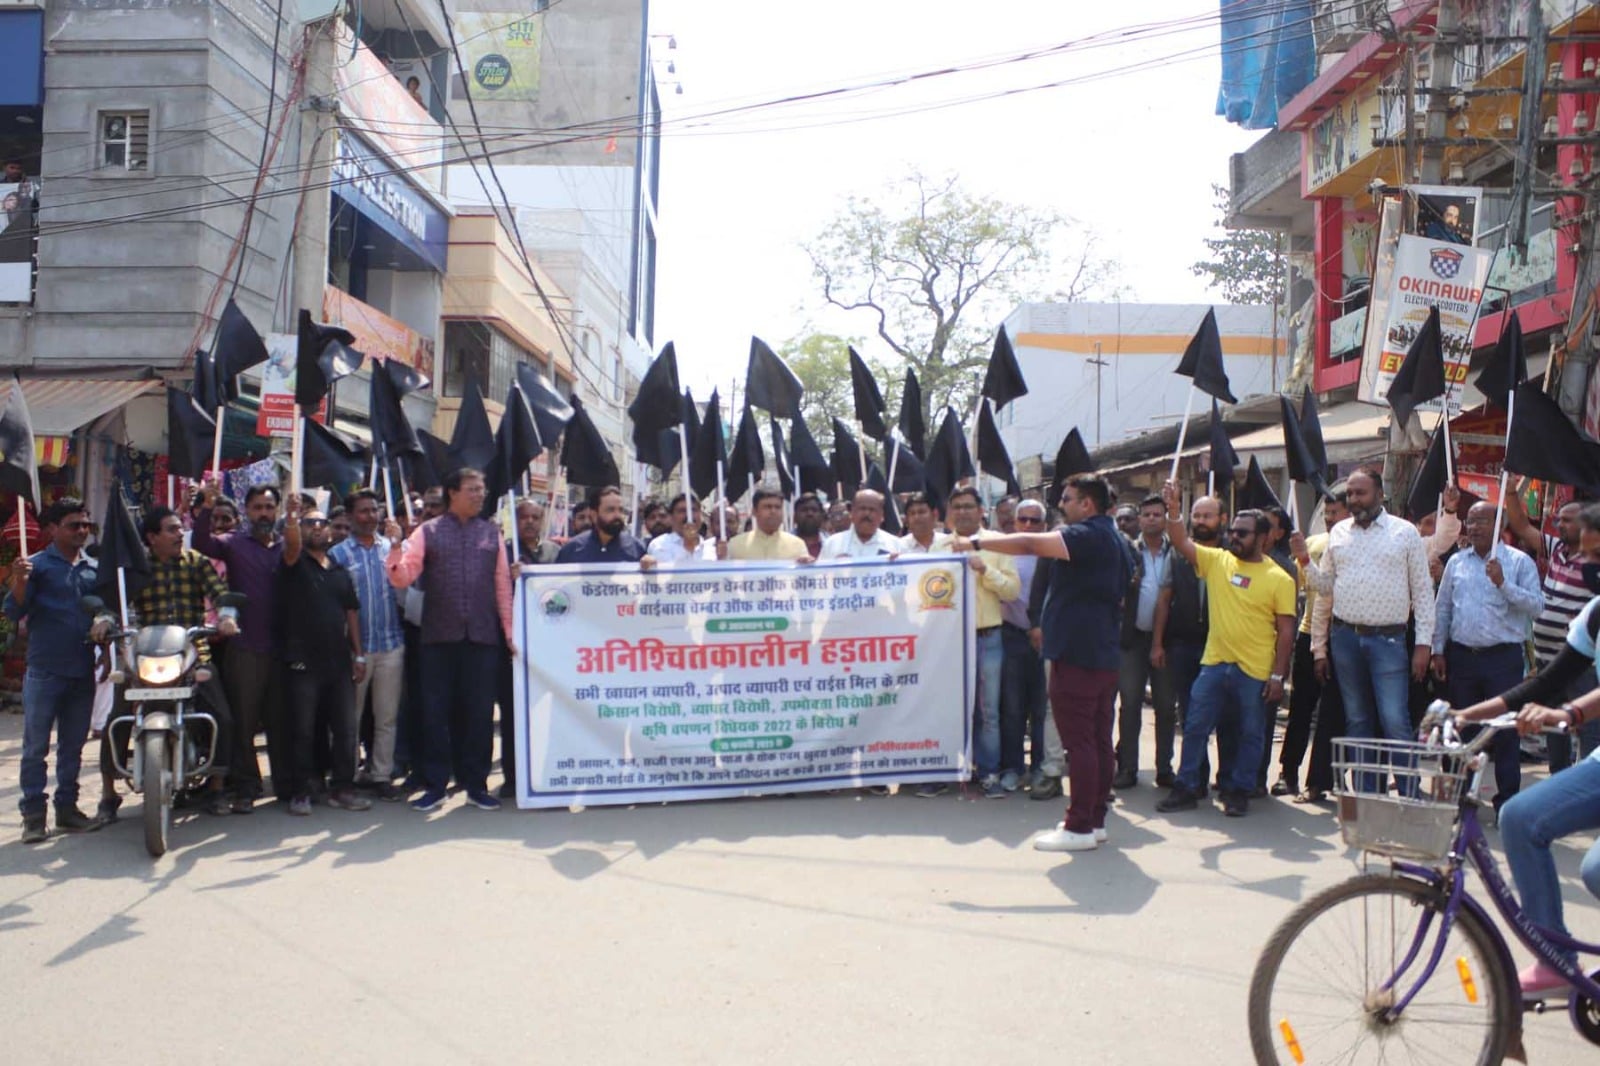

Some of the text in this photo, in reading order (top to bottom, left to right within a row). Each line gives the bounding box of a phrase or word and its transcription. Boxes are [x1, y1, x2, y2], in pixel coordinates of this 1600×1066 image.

[1398, 276, 1481, 305] OKINAWA
[1404, 294, 1434, 307] ELECTRIC
[616, 602, 635, 617] एवं
[576, 634, 918, 674] अनिश्चितकालीन हड़ताल
[575, 684, 599, 700] सभी
[793, 677, 812, 692] एवं
[850, 675, 876, 690] मिल
[881, 674, 893, 688] के
[598, 704, 639, 719] किसान
[643, 702, 686, 719] विरोधी,
[732, 698, 775, 715] विरोधी,
[836, 694, 873, 709] विरोधी
[877, 692, 898, 706] और
[642, 721, 667, 740] कृषि
[763, 719, 791, 733] 2022
[796, 717, 808, 731] के
[849, 712, 860, 728] में
